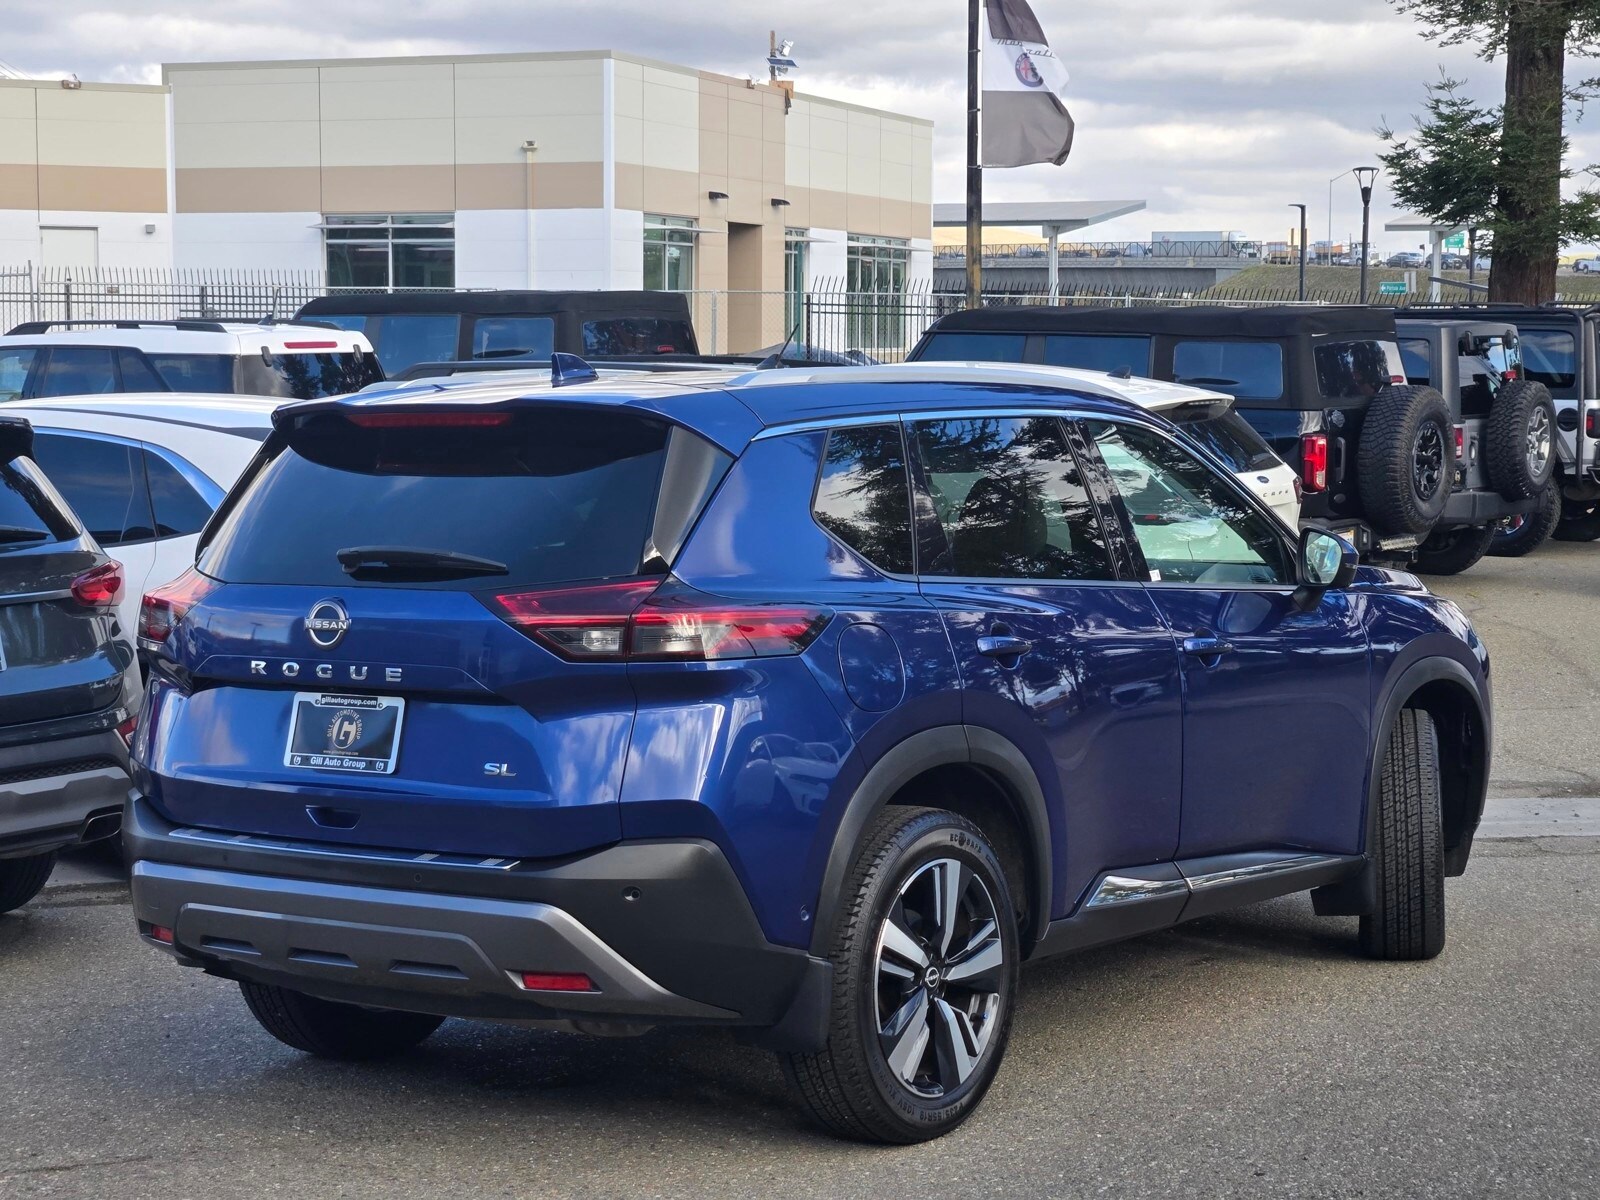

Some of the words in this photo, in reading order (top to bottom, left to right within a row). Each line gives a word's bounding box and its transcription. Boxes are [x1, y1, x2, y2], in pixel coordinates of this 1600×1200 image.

[305, 620, 347, 629] NISSAN
[251, 660, 402, 682] ROGUE
[321, 696, 377, 706] gillautogroup.com
[331, 709, 360, 723] AUTOMOTIVE
[310, 756, 323, 765] Gill
[323, 757, 342, 766] Auto
[343, 759, 366, 770] Group
[484, 763, 517, 776] SL
